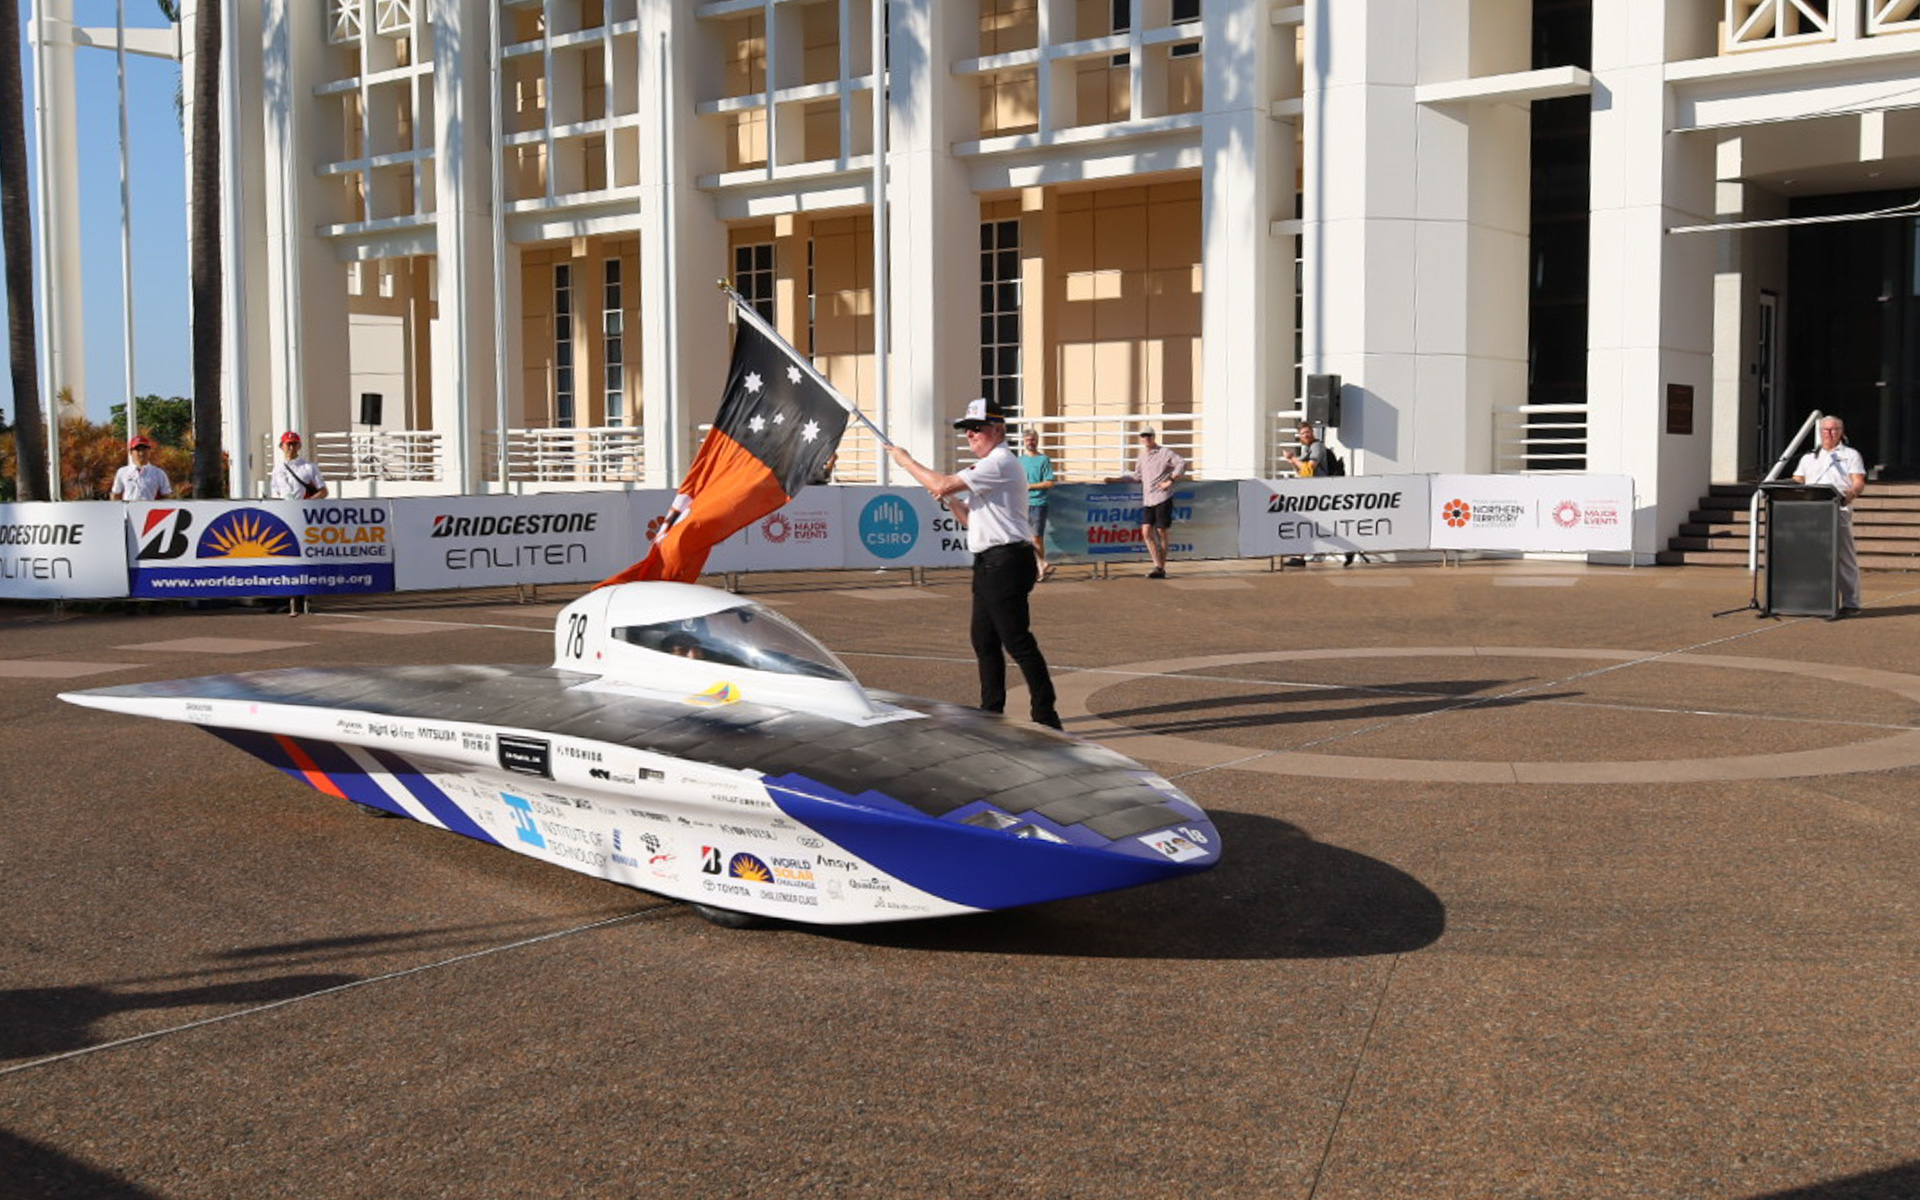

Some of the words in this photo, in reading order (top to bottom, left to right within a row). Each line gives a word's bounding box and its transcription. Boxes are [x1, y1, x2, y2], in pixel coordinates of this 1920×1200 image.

[1267, 491, 1402, 514] BRIDGESTONE
[1473, 505, 1524, 514] NORTHERN
[303, 508, 386, 525] WORLD
[1473, 514, 1519, 523] TERRITORY
[1584, 517, 1618, 525] EVENTS
[431, 512, 598, 538] BRIDGESTONE
[794, 521, 828, 531] MAJOR
[1279, 518, 1392, 540] ENLITEN
[304, 526, 386, 544] SOLAR
[794, 531, 828, 539] EVENTS
[867, 533, 912, 545] CSIRO
[305, 545, 386, 558] CHALLENGE
[446, 543, 587, 570] ENLITEN
[151, 574, 373, 588] www.worldsolarchallenge.org
[566, 613, 588, 659] 78
[418, 726, 457, 742] MITSUBA
[770, 856, 811, 870] WORLD
[817, 854, 858, 872] Ansys
[773, 867, 814, 881] SOLAR
[717, 883, 751, 897] TOYOTA
